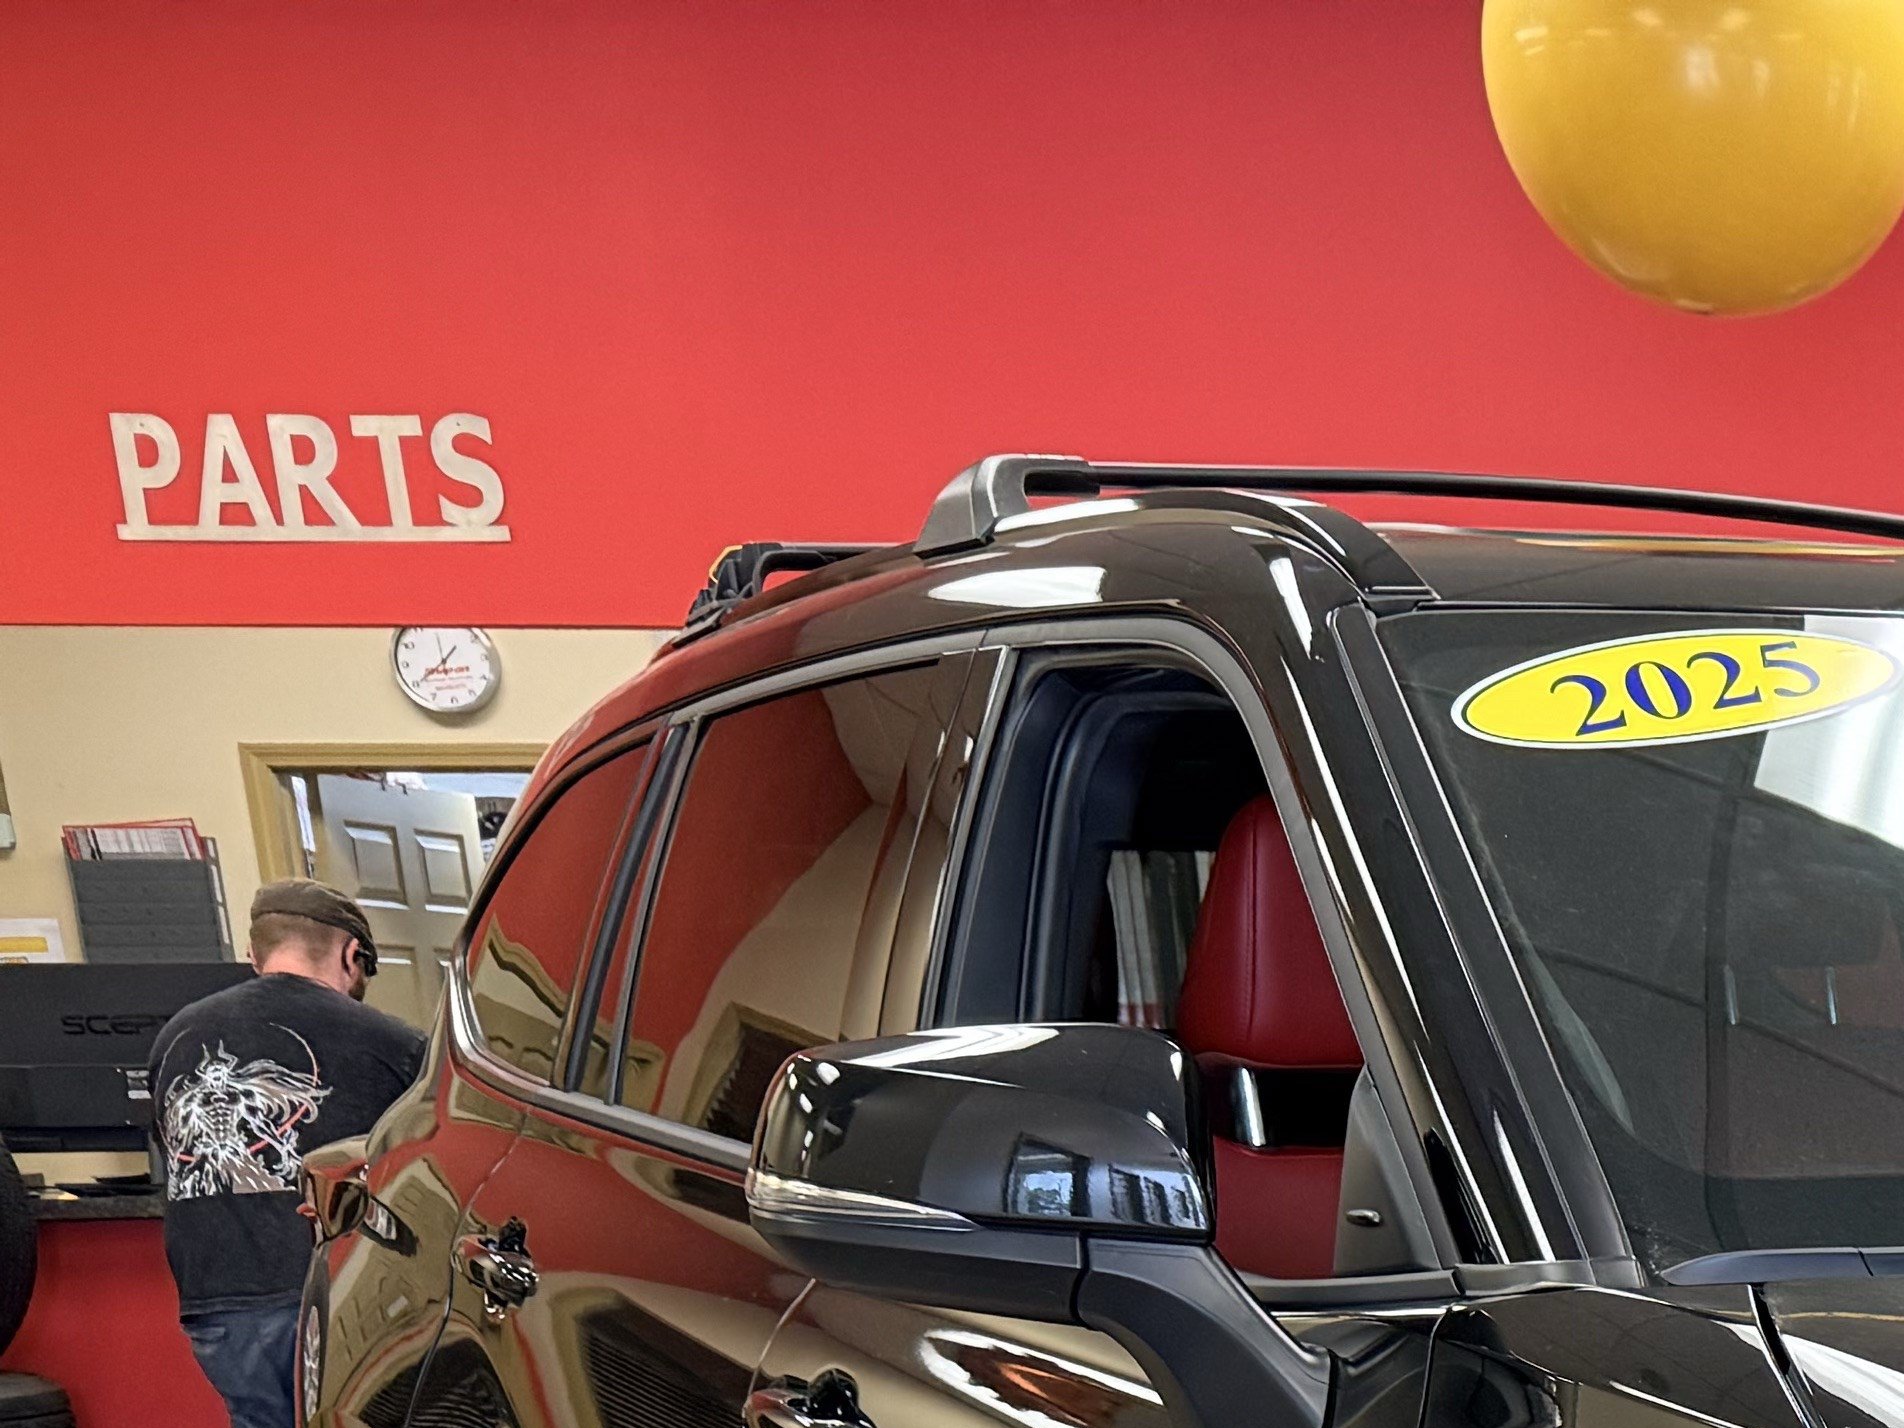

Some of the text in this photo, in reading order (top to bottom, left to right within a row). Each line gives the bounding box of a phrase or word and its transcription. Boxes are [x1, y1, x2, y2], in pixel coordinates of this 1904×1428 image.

[109, 412, 506, 528] PARTS
[1550, 641, 1820, 736] 2025
[61, 1014, 171, 1035] SCEP
